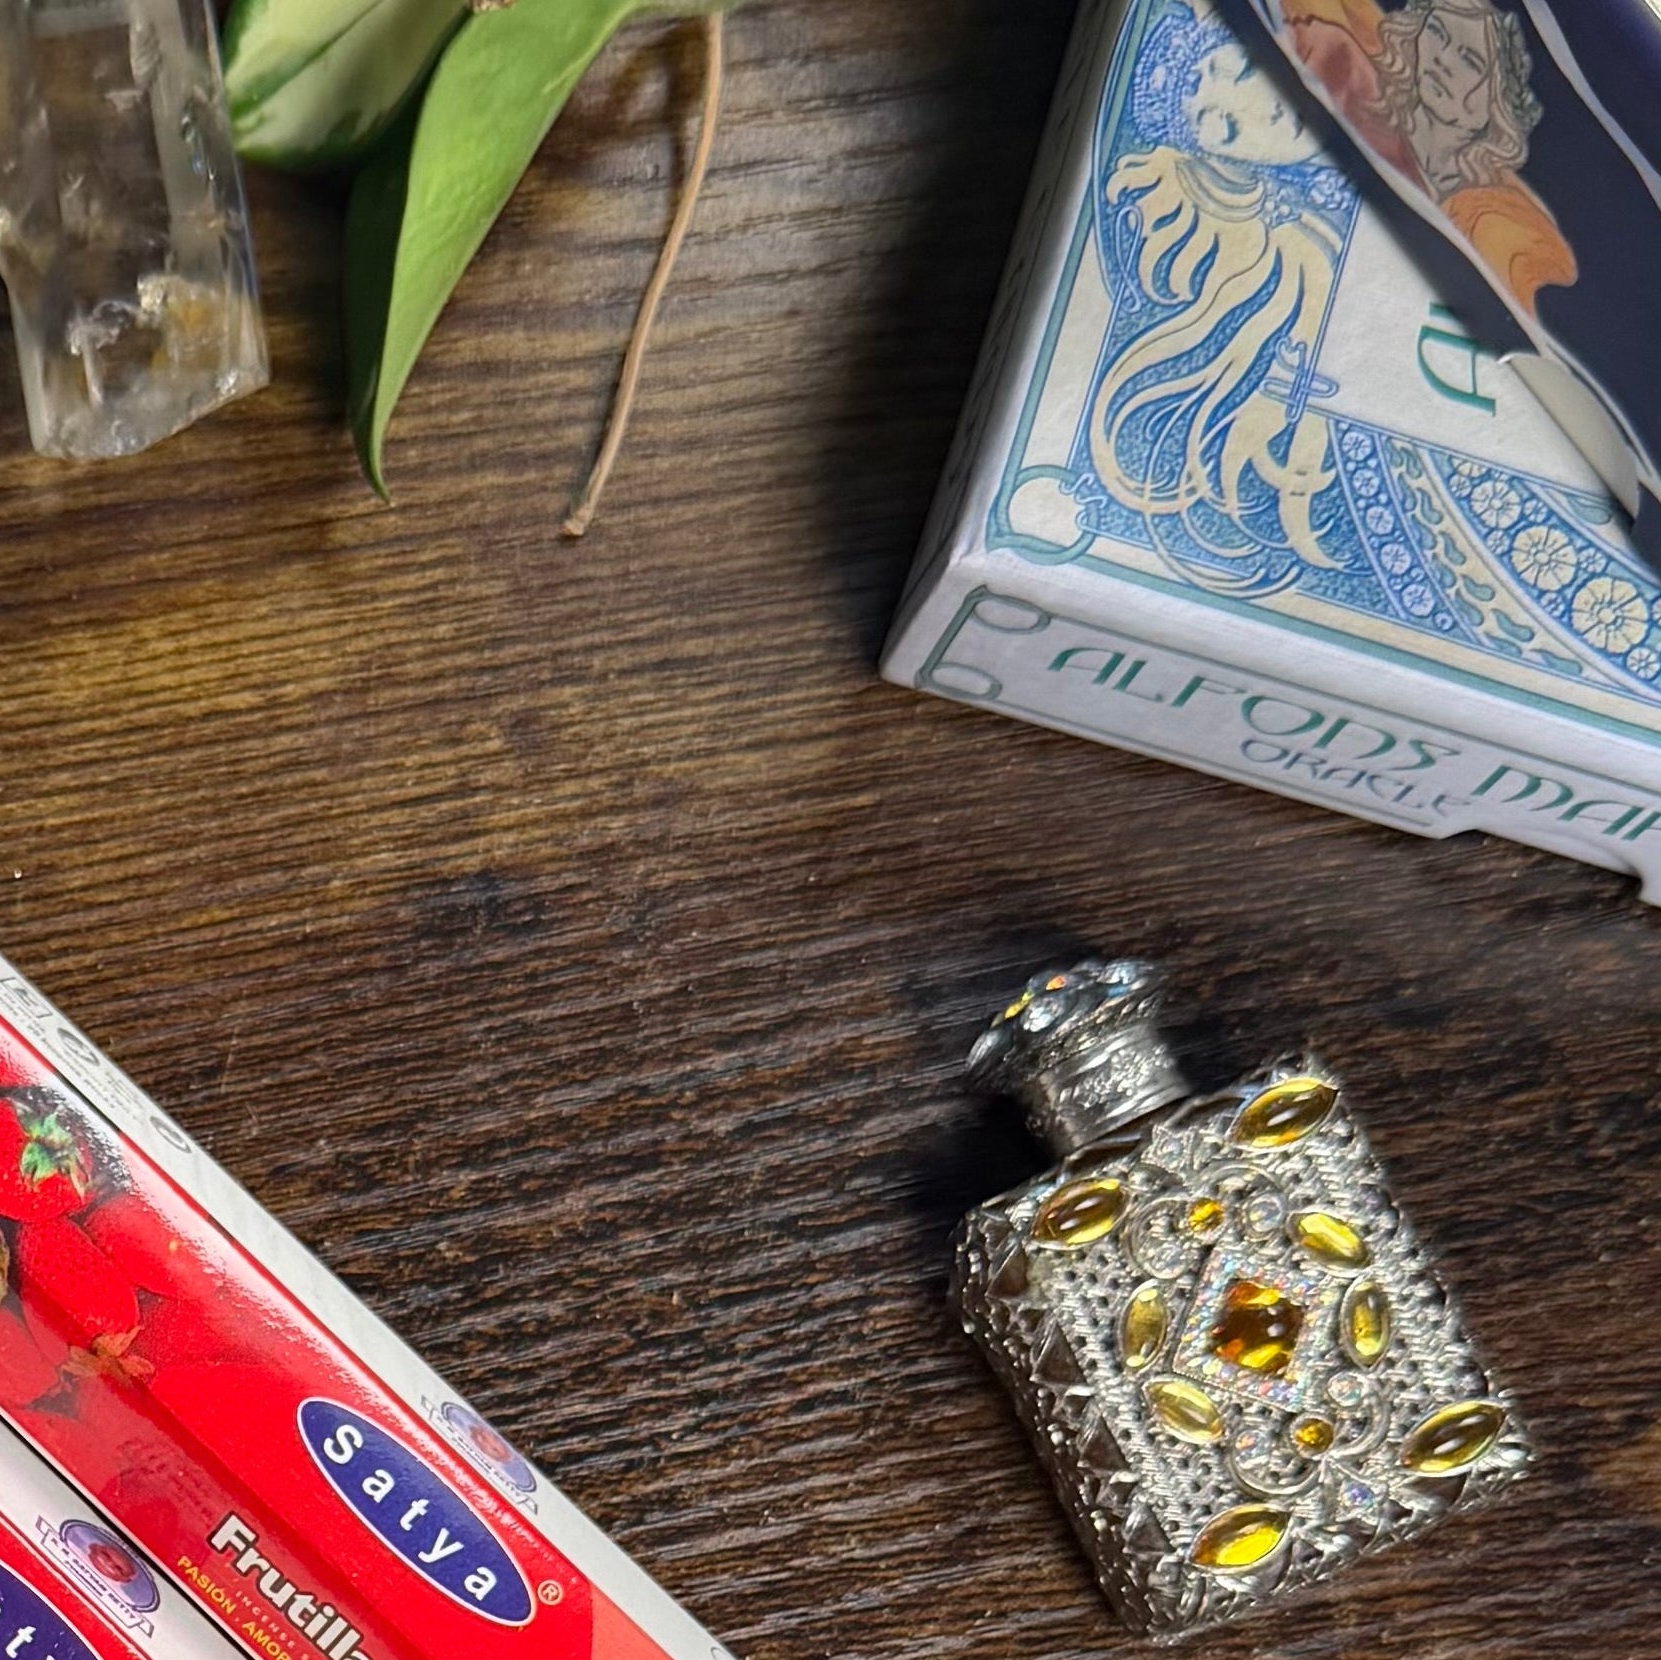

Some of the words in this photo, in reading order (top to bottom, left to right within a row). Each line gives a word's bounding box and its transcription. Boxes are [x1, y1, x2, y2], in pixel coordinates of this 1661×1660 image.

[1046, 647, 1462, 772] ALFONS
[1241, 738, 1471, 816] ORACLE
[324, 1424, 497, 1601] Satya
[177, 1556, 236, 1613] PASIÓN
[235, 1590, 294, 1647] INCENSE
